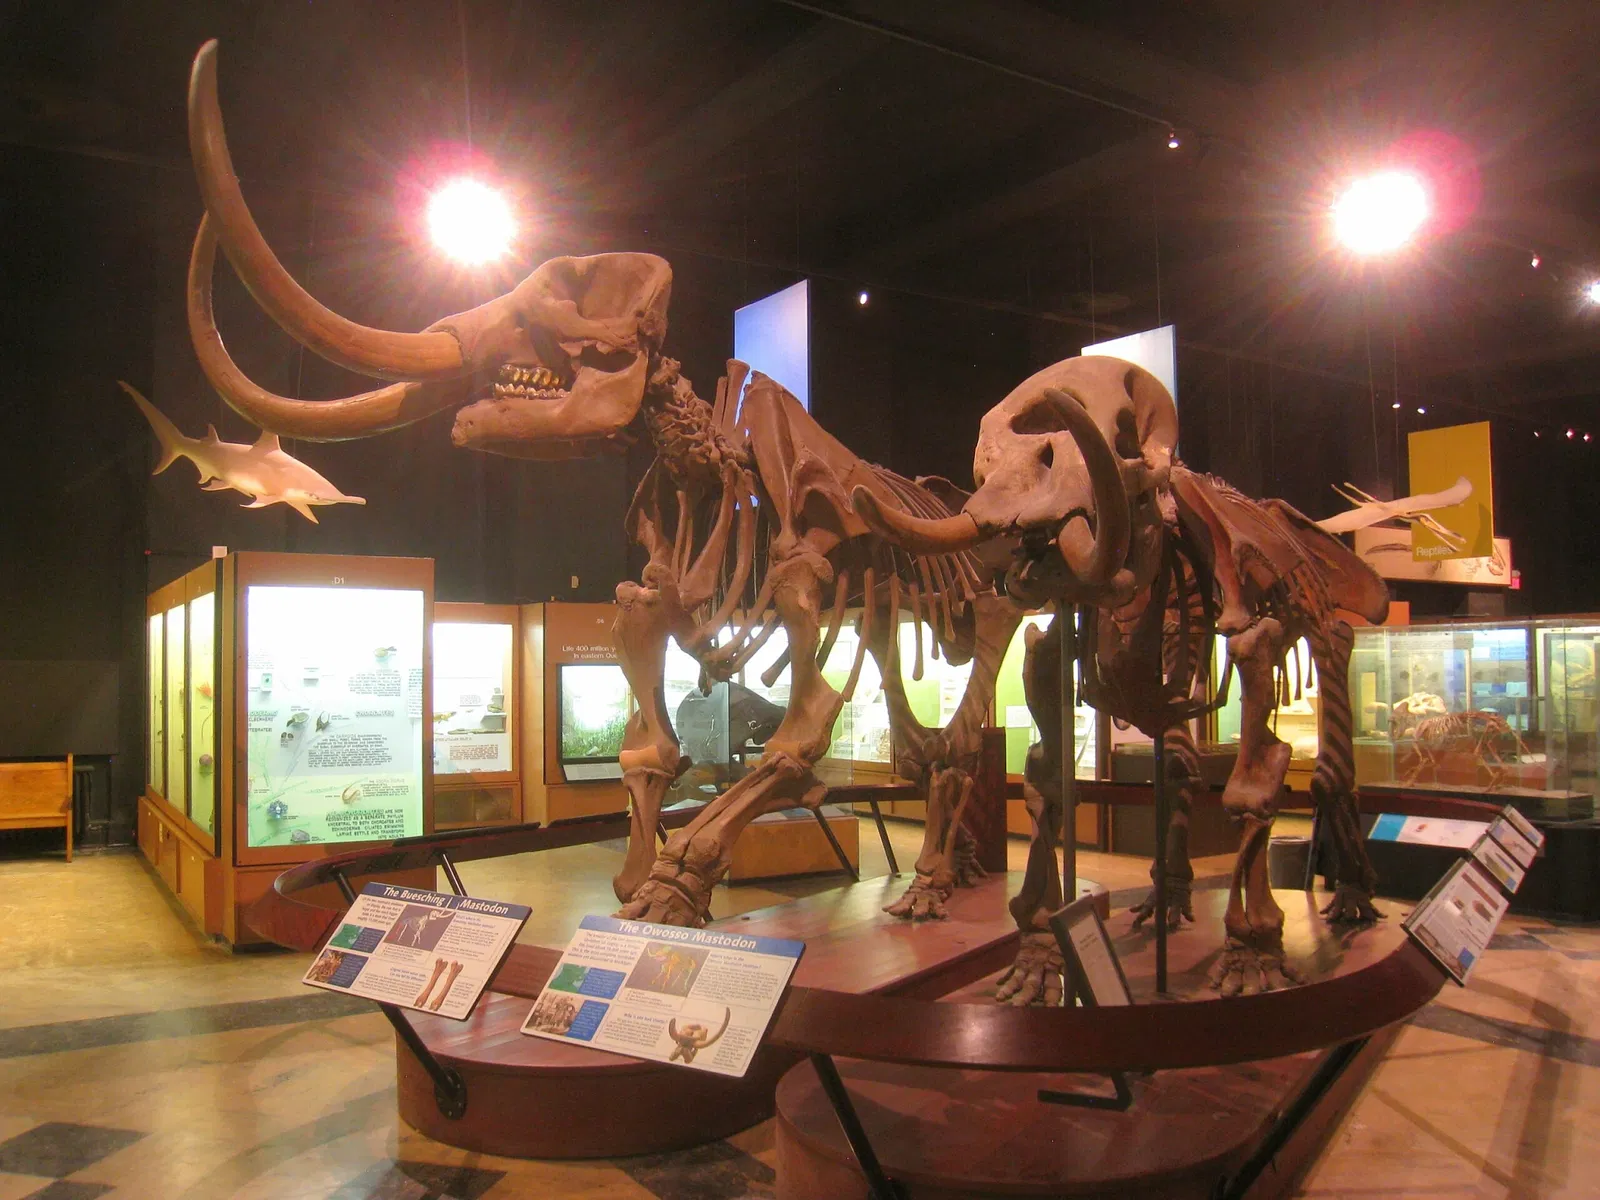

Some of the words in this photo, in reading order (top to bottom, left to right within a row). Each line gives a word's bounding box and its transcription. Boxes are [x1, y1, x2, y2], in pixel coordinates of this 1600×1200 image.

[1416, 546, 1452, 559] Reptiles
[383, 886, 399, 898] The
[400, 888, 446, 907] Buesching
[459, 899, 509, 915] Mastodon
[618, 921, 640, 935] The
[641, 925, 690, 942] Owosso
[691, 931, 757, 949] Mastodon
